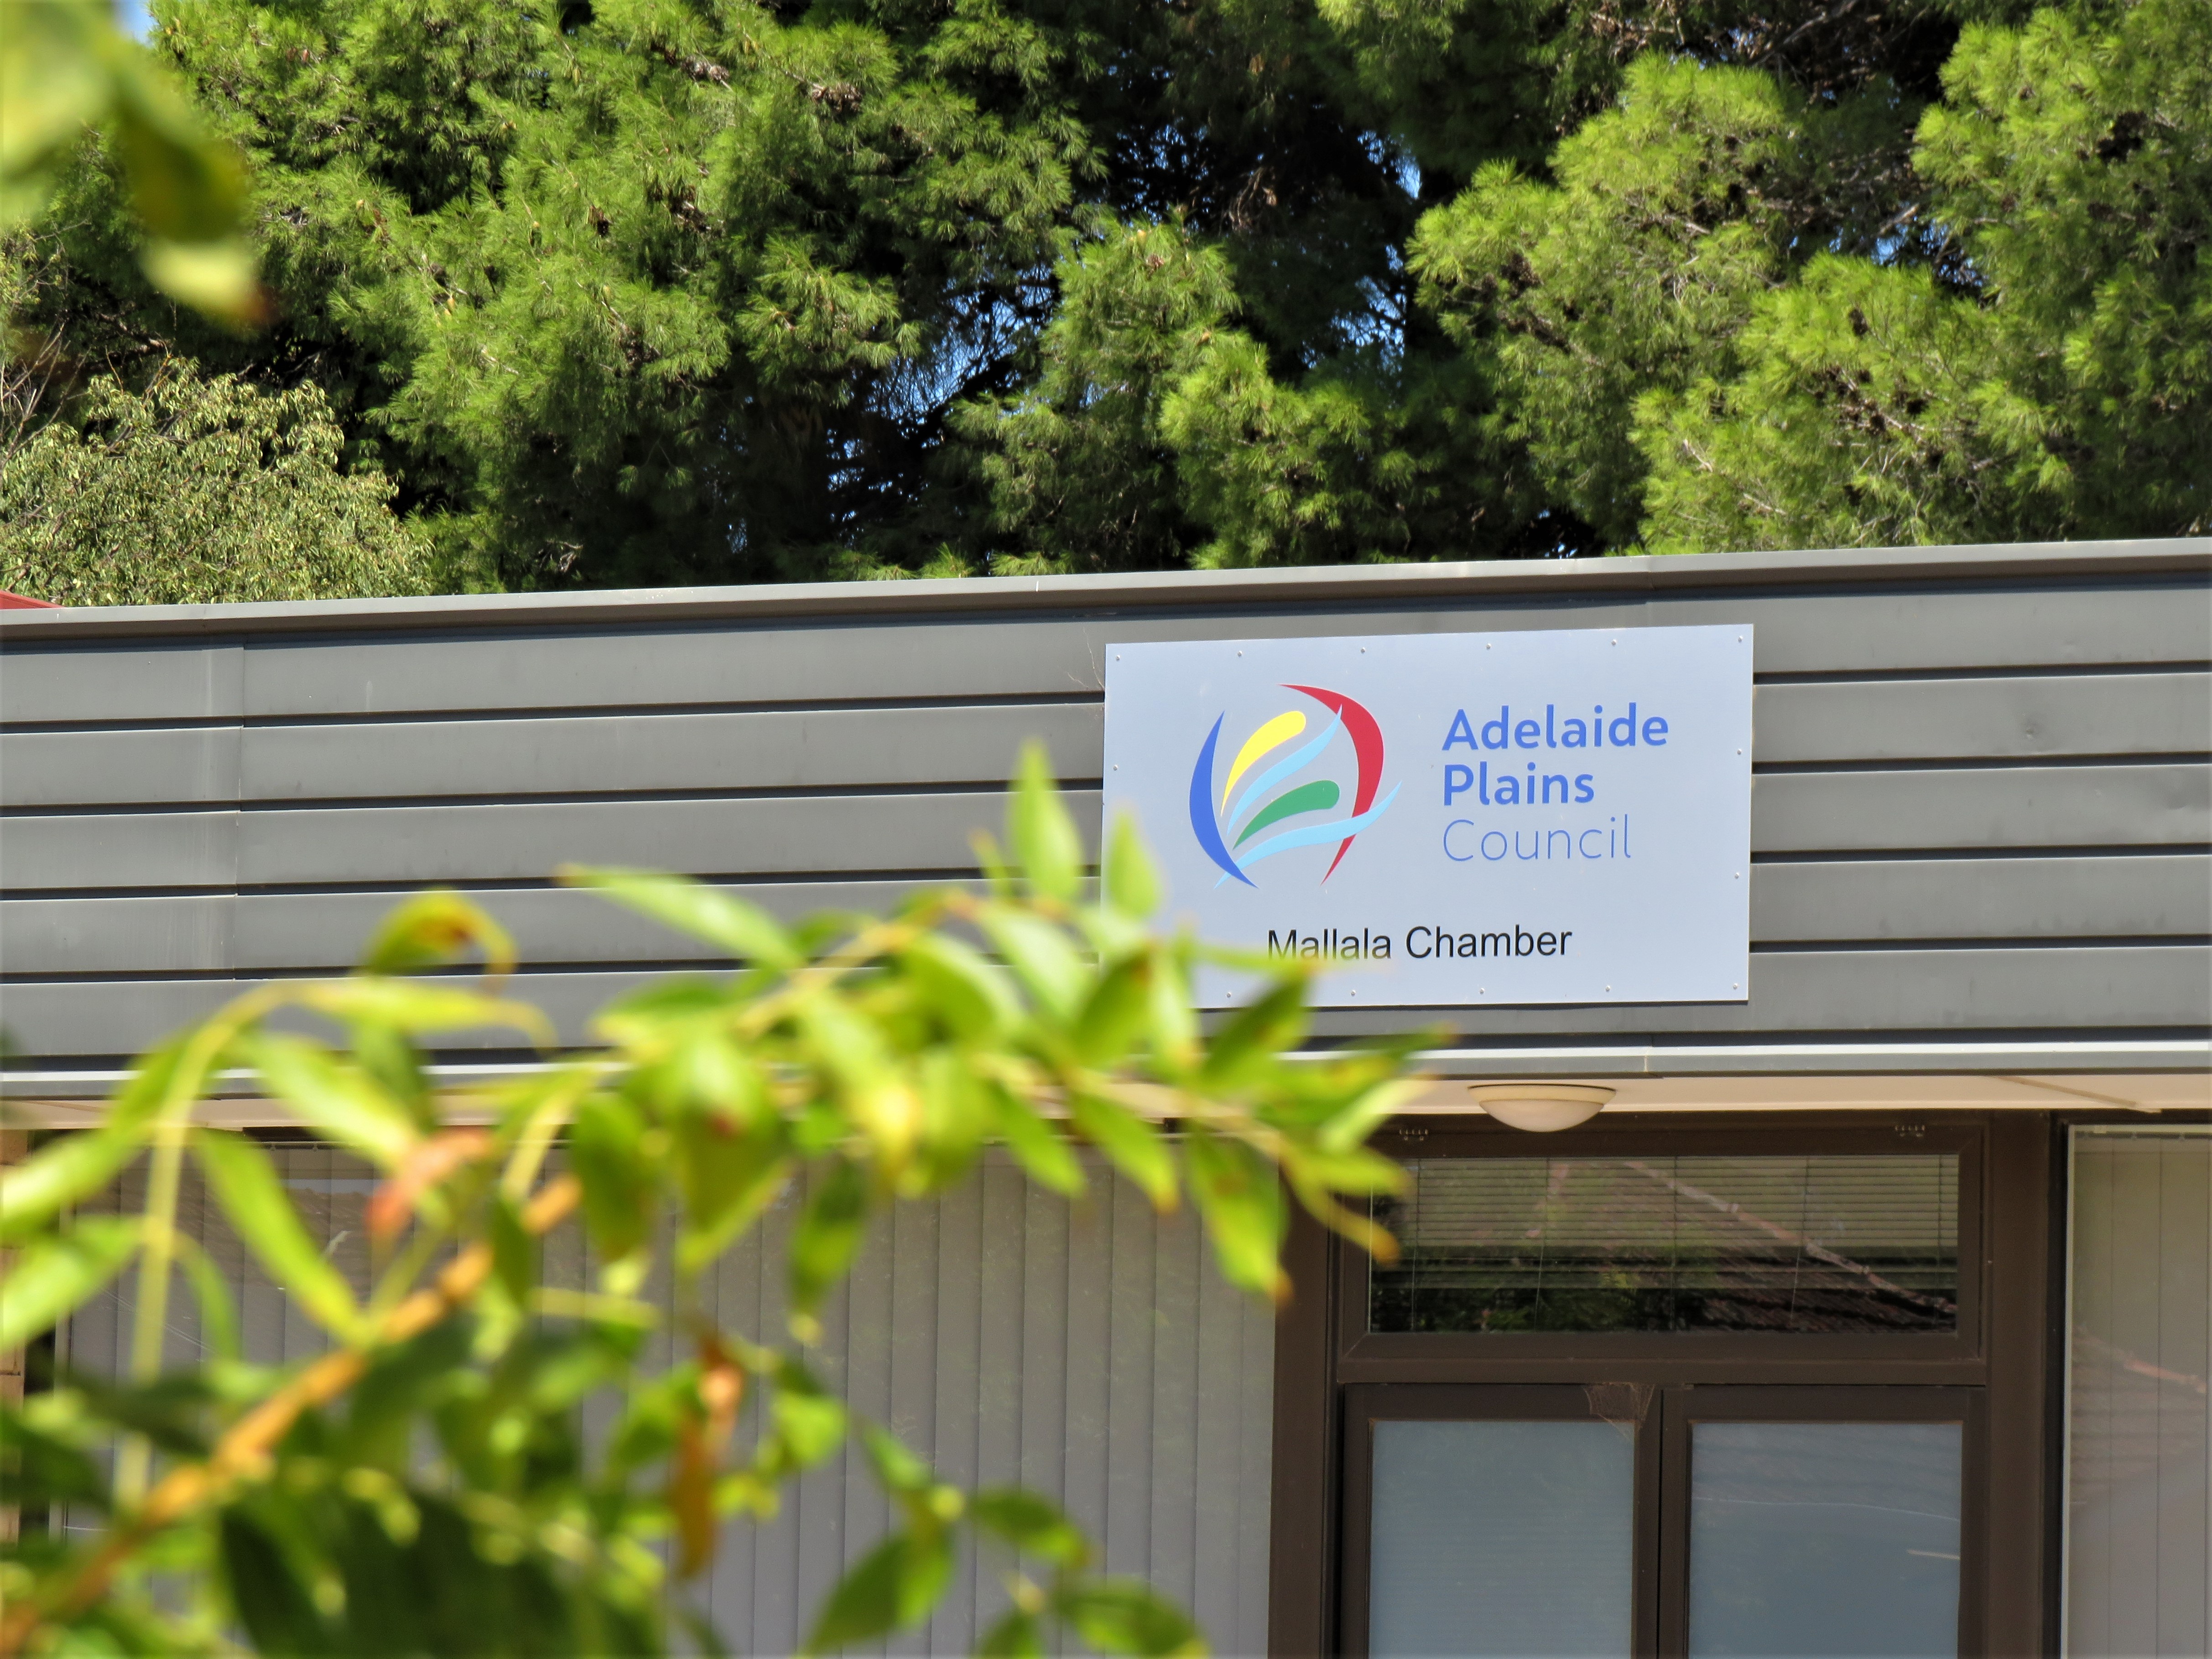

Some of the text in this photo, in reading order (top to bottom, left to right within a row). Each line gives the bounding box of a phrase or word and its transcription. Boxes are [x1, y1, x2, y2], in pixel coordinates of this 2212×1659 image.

[1441, 702, 1669, 751] Adelaide
[1443, 760, 1595, 806] Plains
[1442, 813, 1632, 862] Council
[1267, 924, 1573, 961] Mallala Chamber
